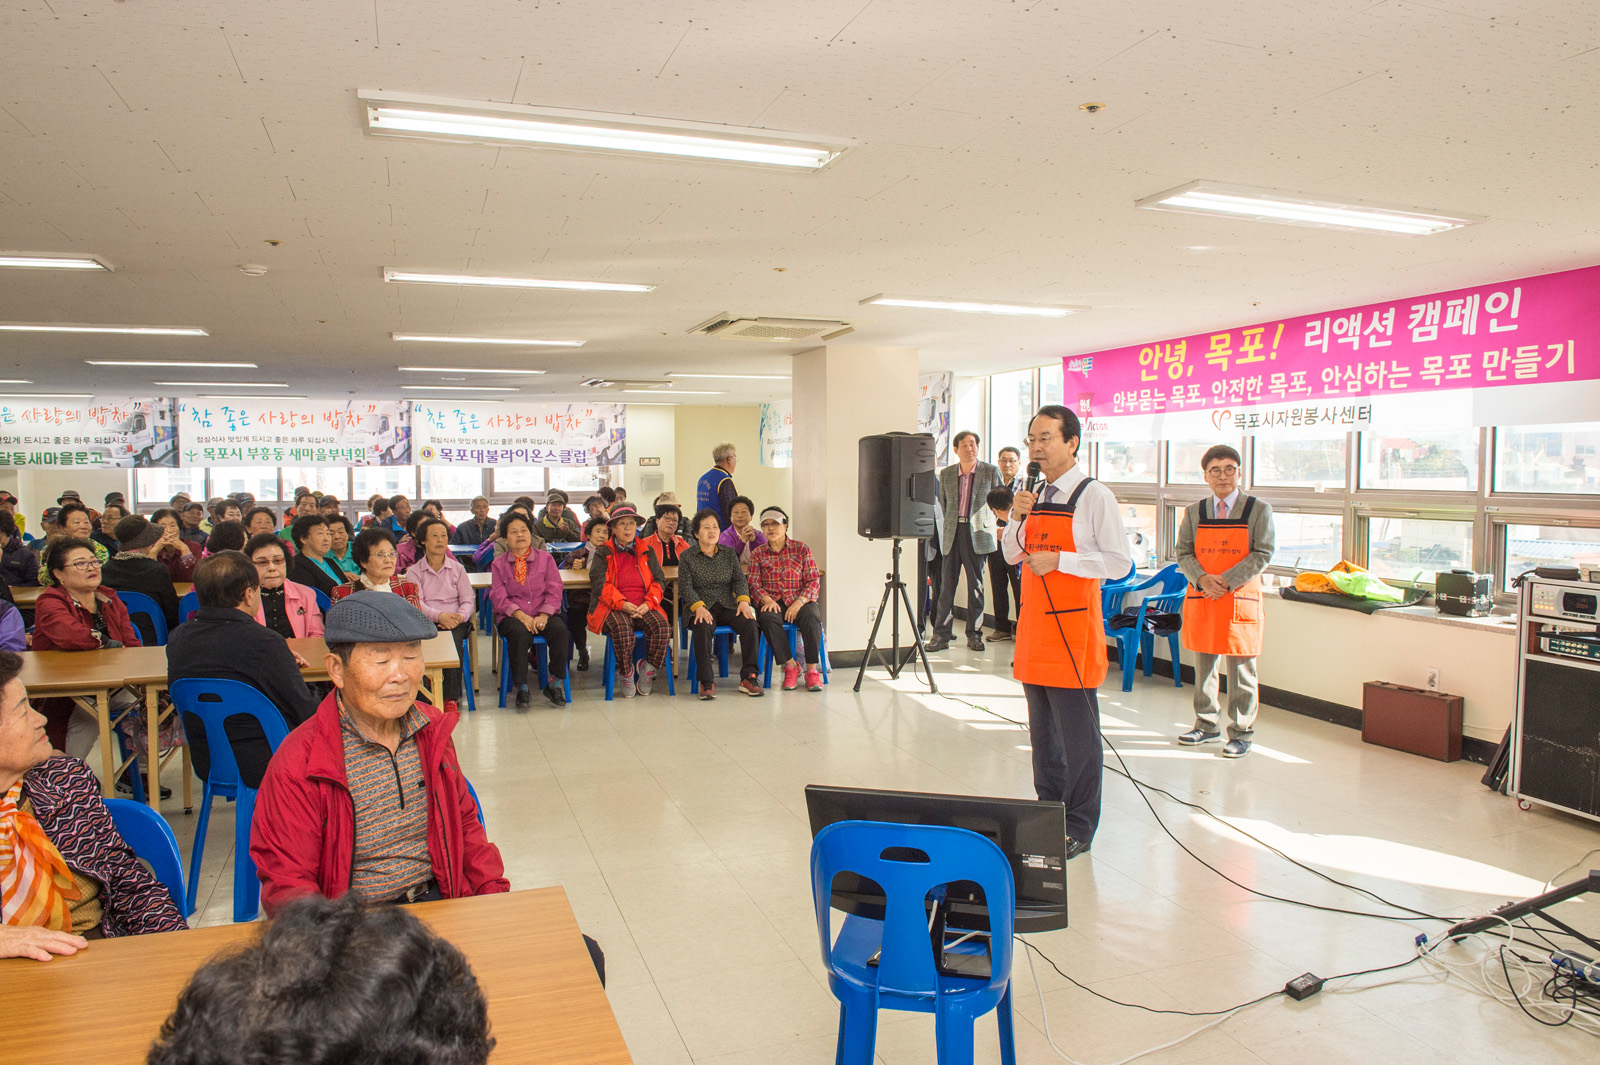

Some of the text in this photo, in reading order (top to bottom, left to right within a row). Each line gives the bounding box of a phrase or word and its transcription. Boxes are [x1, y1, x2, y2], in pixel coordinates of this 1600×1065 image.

[1138, 287, 1522, 382] 안녕, 목포! 리액션 캠페인
[1113, 340, 1575, 414] 안부묻는 목포, 안전한 목포, 안심하는 목포 만들기
[0, 406, 13, 424] 은
[21, 406, 79, 424] 사랑의
[220, 406, 251, 432] 좋은
[258, 410, 314, 428] 사랑의
[453, 409, 480, 434] 좋은
[487, 412, 537, 431] 사랑의
[1233, 404, 1373, 431] 목포시자원봉사센터
[24, 436, 51, 444] 드시고
[202, 446, 366, 462] 목포시 부흥동 새마을부녀회
[439, 447, 587, 464] 목포대불라이온스클럽
